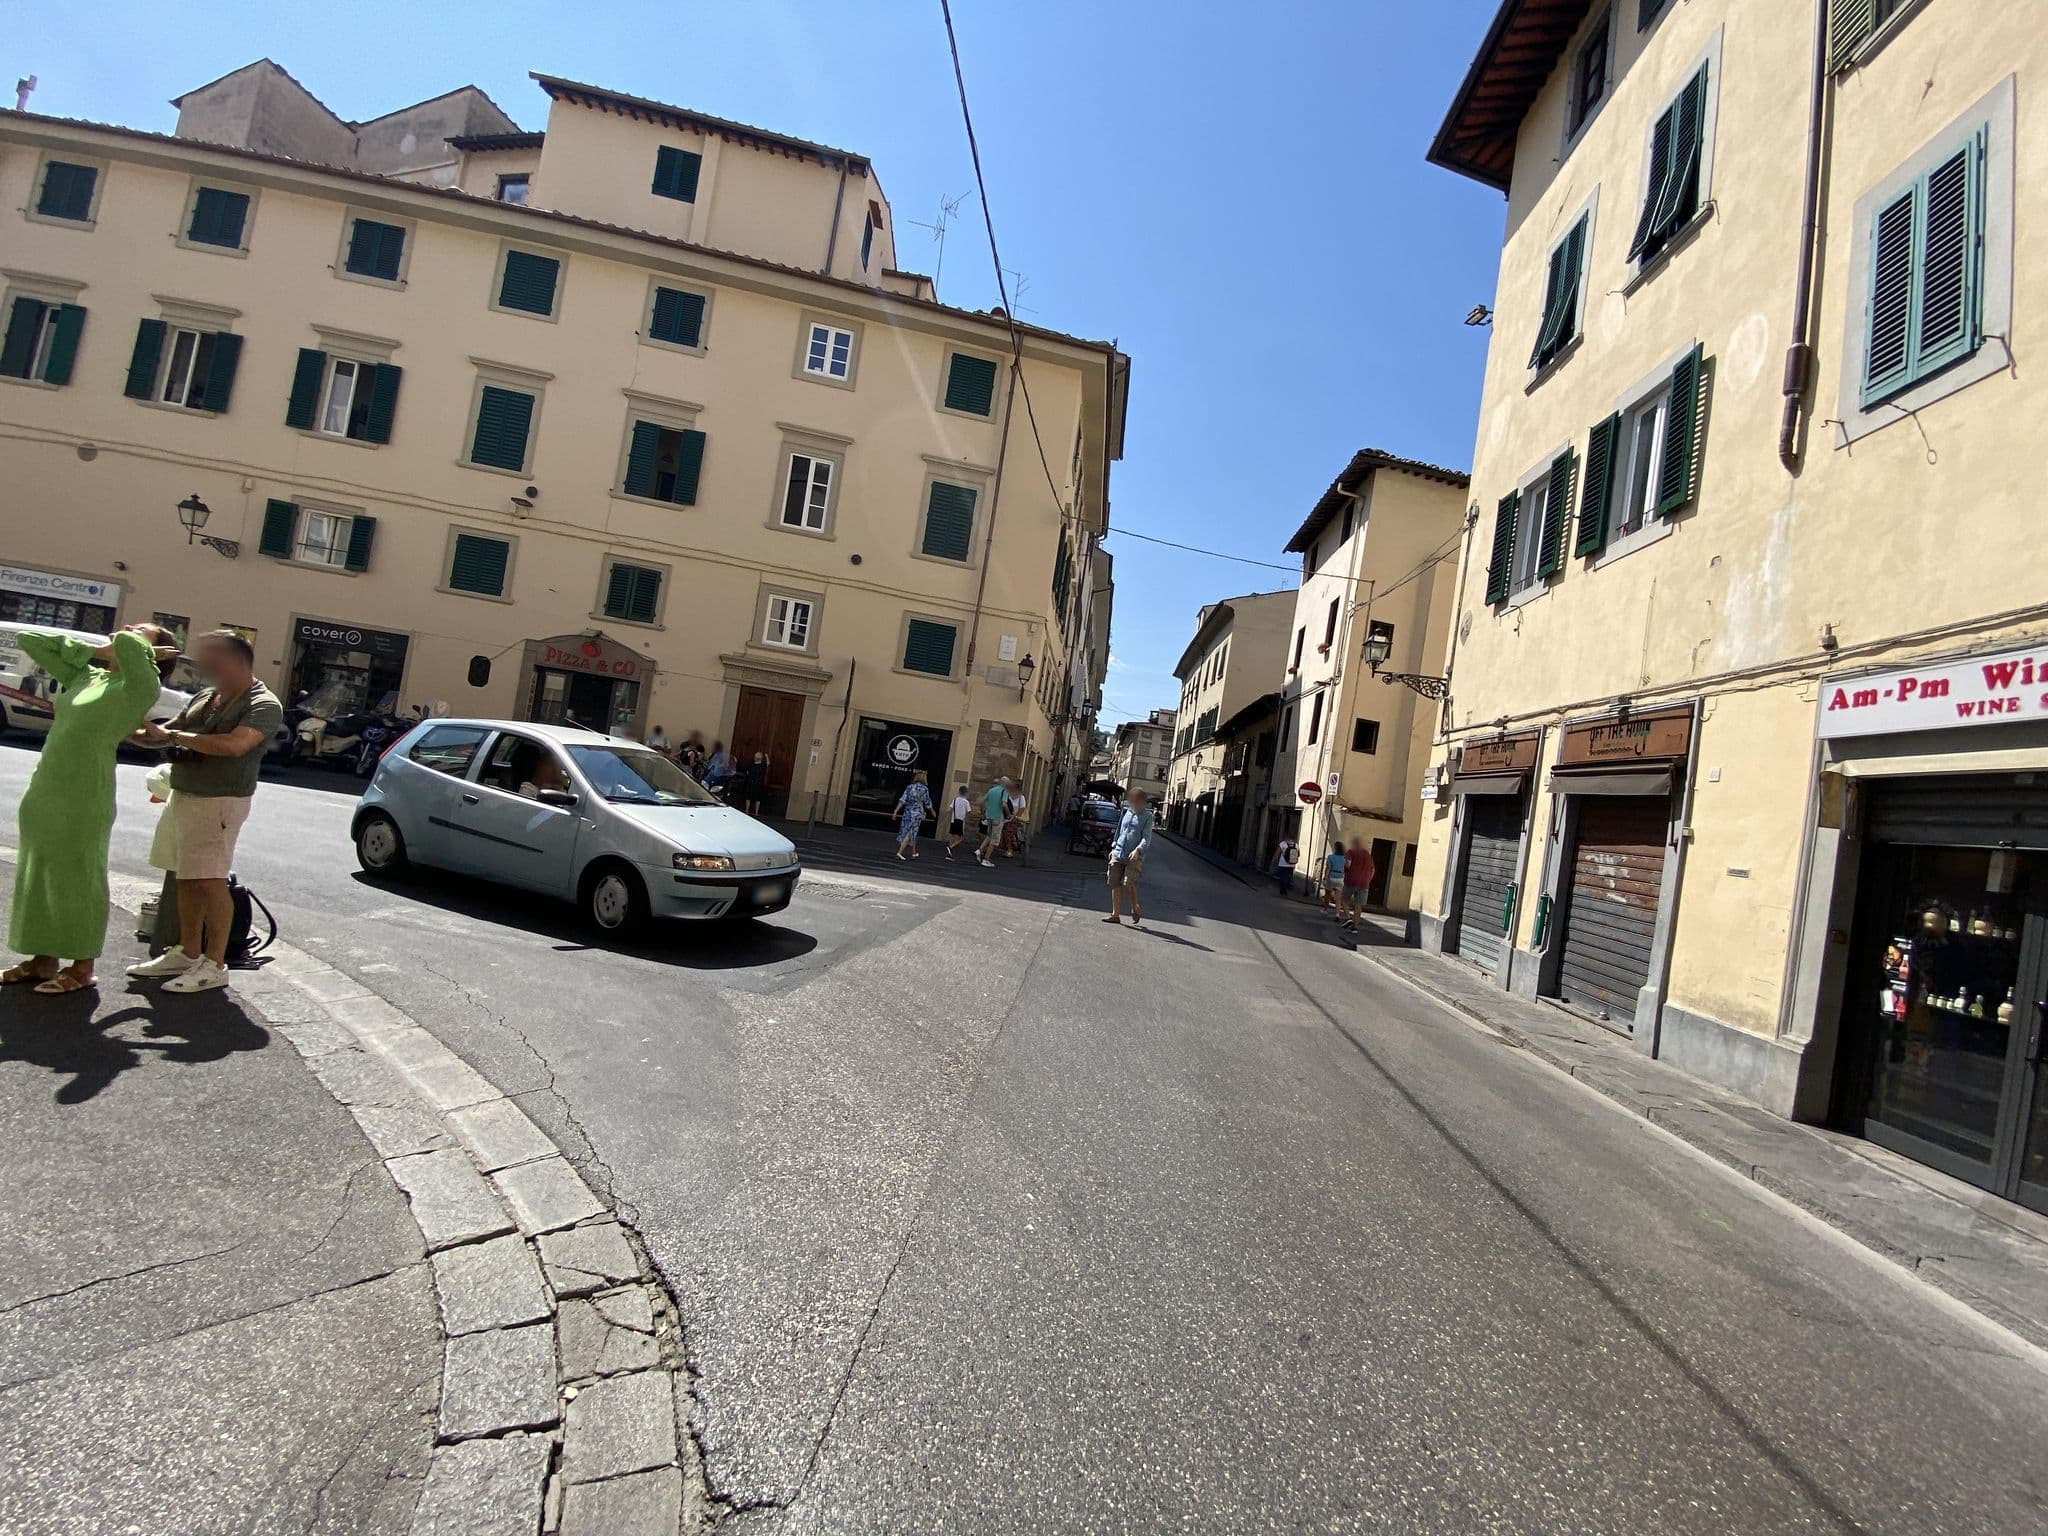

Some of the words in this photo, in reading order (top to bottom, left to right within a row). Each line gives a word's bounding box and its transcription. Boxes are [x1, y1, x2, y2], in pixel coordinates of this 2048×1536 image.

[1, 569, 49, 587] Firenze
[302, 626, 344, 640] cover
[545, 645, 590, 669] PIZZA
[596, 660, 608, 672] &
[612, 661, 636, 676] CO
[1828, 677, 1949, 711] Am-Pm
[1956, 697, 2020, 717] WINE
